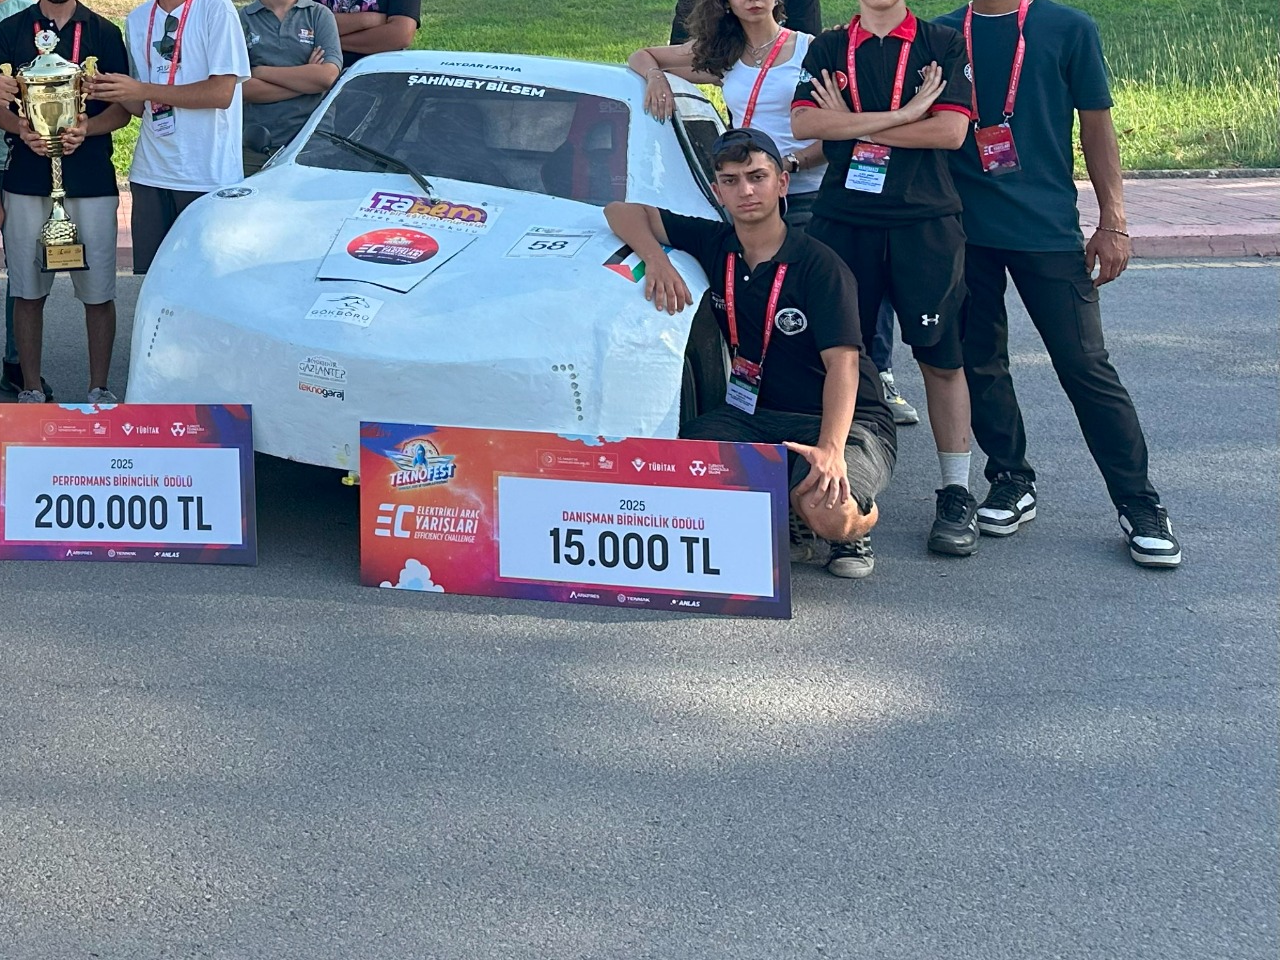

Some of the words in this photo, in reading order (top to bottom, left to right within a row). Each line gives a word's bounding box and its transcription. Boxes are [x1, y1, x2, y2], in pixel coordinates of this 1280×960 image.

[485, 64, 521, 72] FATMA
[407, 74, 486, 90] ŞAHİNBEY
[486, 81, 546, 98] BİLSEM
[372, 193, 485, 224] Fabem
[527, 240, 569, 251] 58
[311, 309, 370, 321] GÖKBÖRÜ
[299, 381, 345, 401] teknogaraj
[136, 425, 160, 435] TÜBİTAK
[110, 458, 133, 469] 2025
[648, 462, 676, 473] TÜBİTAK
[52, 475, 111, 487] PERFORMANS
[113, 474, 159, 487] BİRİNCİLİK
[163, 475, 193, 487] ÖDÜLÜ
[389, 463, 457, 488] TEKNOFEST
[417, 505, 458, 517] ELEKTRİKLİ
[619, 499, 646, 511] 2025
[34, 493, 168, 530] 200.000
[177, 495, 212, 531] TL
[374, 503, 415, 538] EC
[415, 515, 479, 534] YARIŞLARI
[562, 510, 614, 525] DANIŞMAN
[616, 513, 670, 528] BİRİNCİLİK
[671, 516, 705, 530] ÖDÜLÜ
[414, 531, 444, 541] EFFICIENCY
[444, 533, 476, 543] CHALLENGE
[549, 527, 669, 572] 15.000
[680, 536, 720, 575] TL
[678, 599, 701, 608] ANLAS
